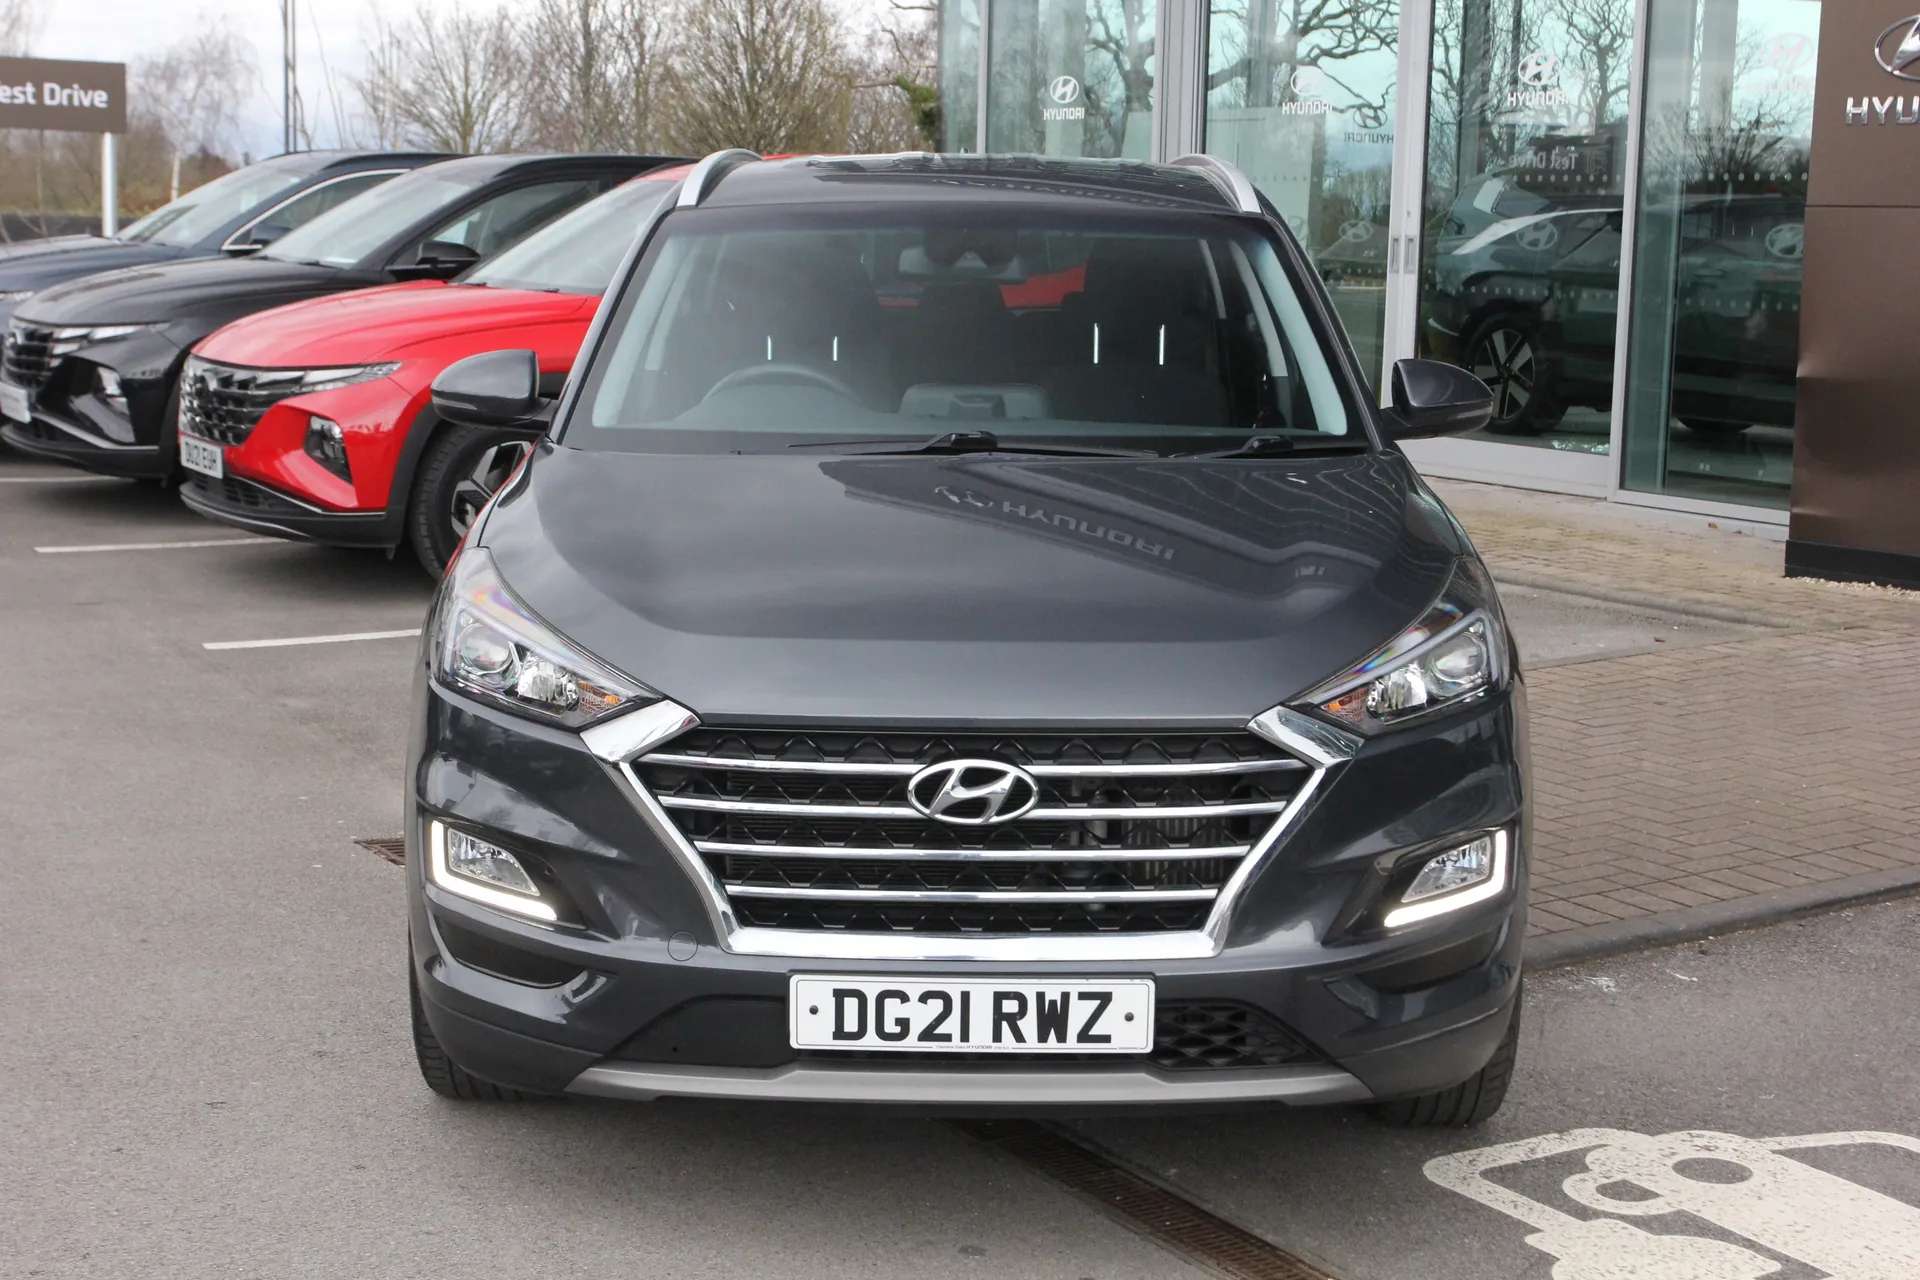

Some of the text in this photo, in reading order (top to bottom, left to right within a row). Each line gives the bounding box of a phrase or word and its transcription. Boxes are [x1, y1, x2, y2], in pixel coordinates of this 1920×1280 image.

[0, 82, 109, 108] est Drive
[1043, 107, 1085, 120] HYUNDAI
[1282, 101, 1333, 115] HYUNDAI
[832, 988, 1114, 1044] DG21 RWZ
